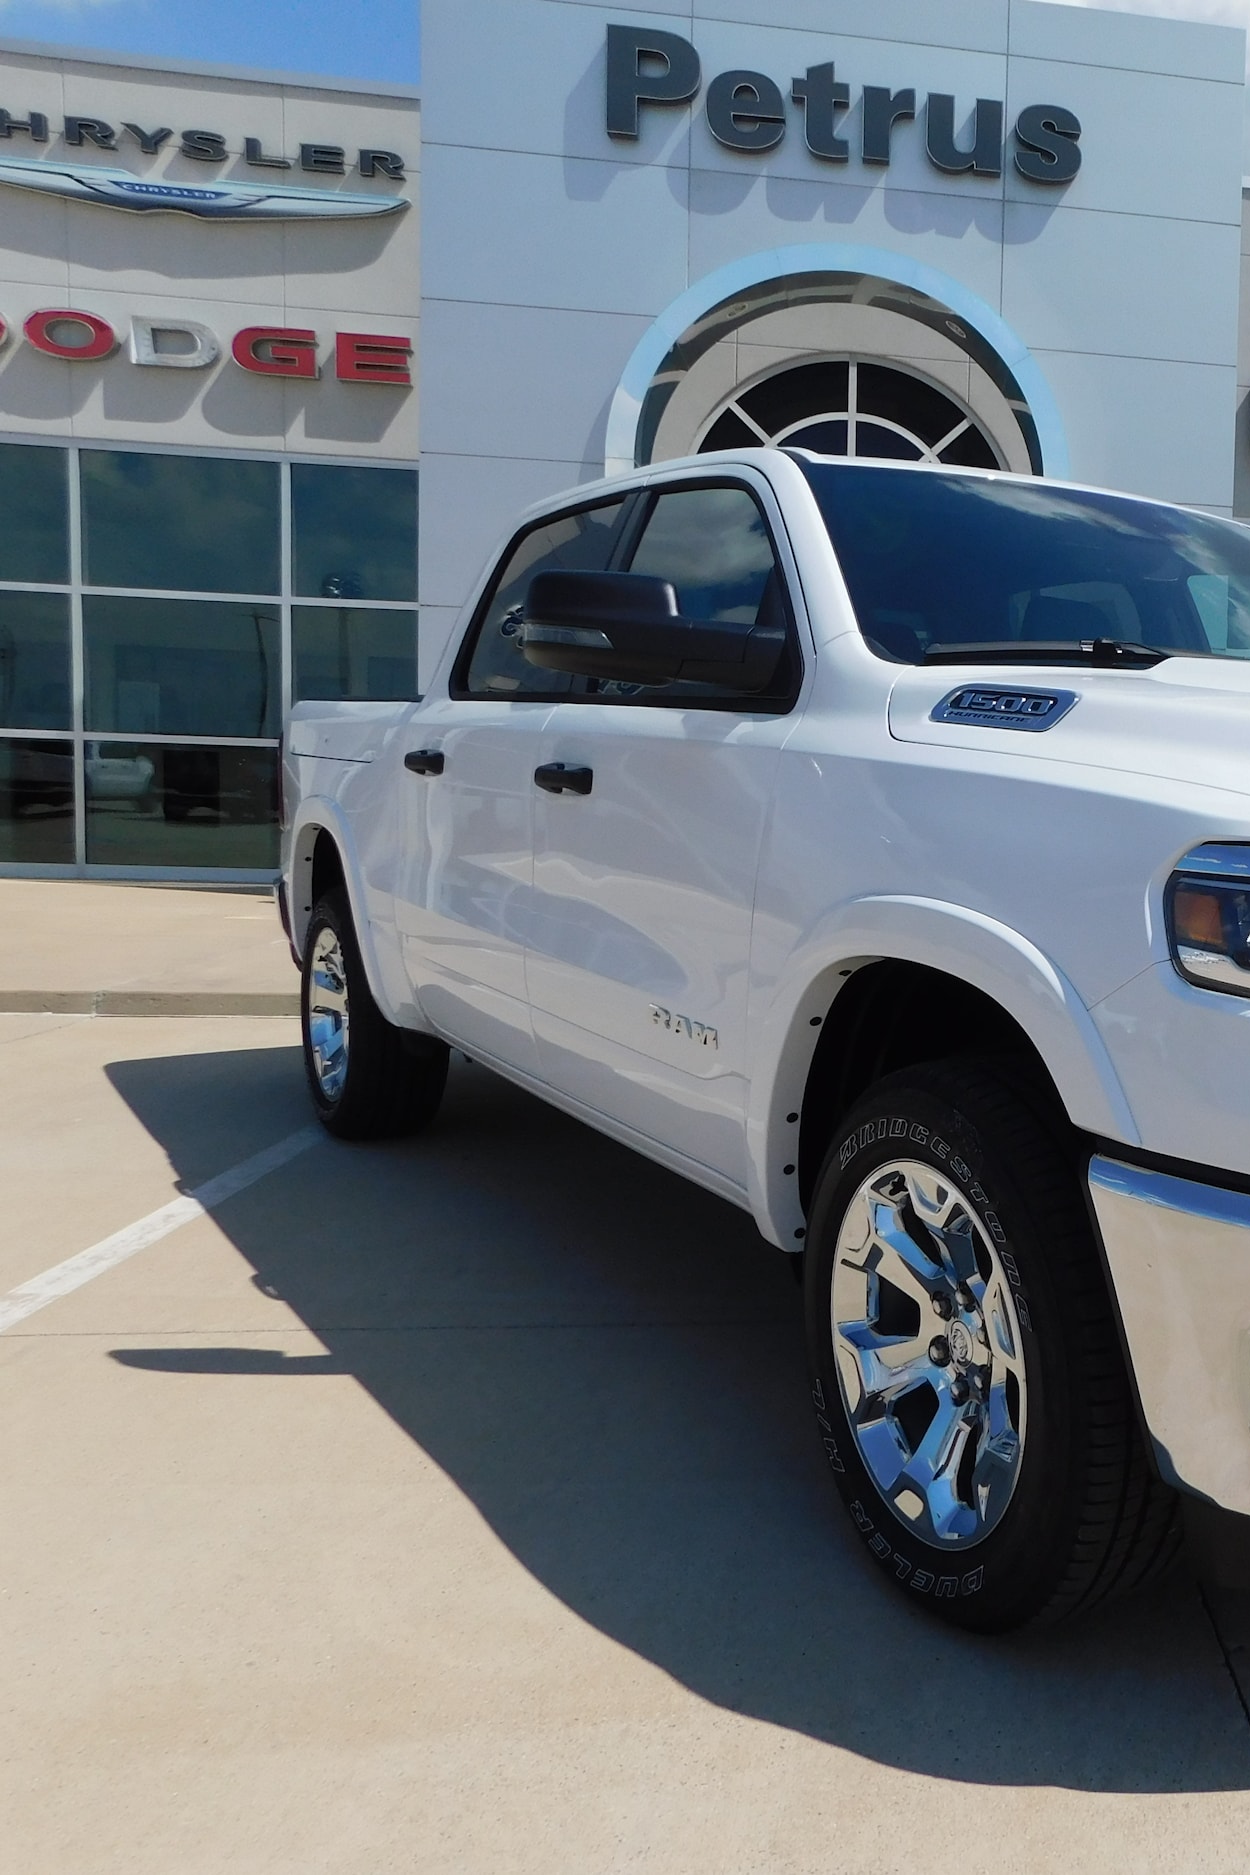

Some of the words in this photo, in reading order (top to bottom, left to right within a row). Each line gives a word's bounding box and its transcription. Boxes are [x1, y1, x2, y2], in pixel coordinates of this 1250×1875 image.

[605, 23, 1083, 185] Petrus
[121, 183, 217, 199] CHRYSLER
[0, 308, 413, 386] ODGE
[948, 710, 1031, 723] HURRICANE
[958, 691, 1055, 716] 1500
[838, 1117, 1033, 1332] BRIDGESTONE
[849, 1499, 985, 1598] DUELER
